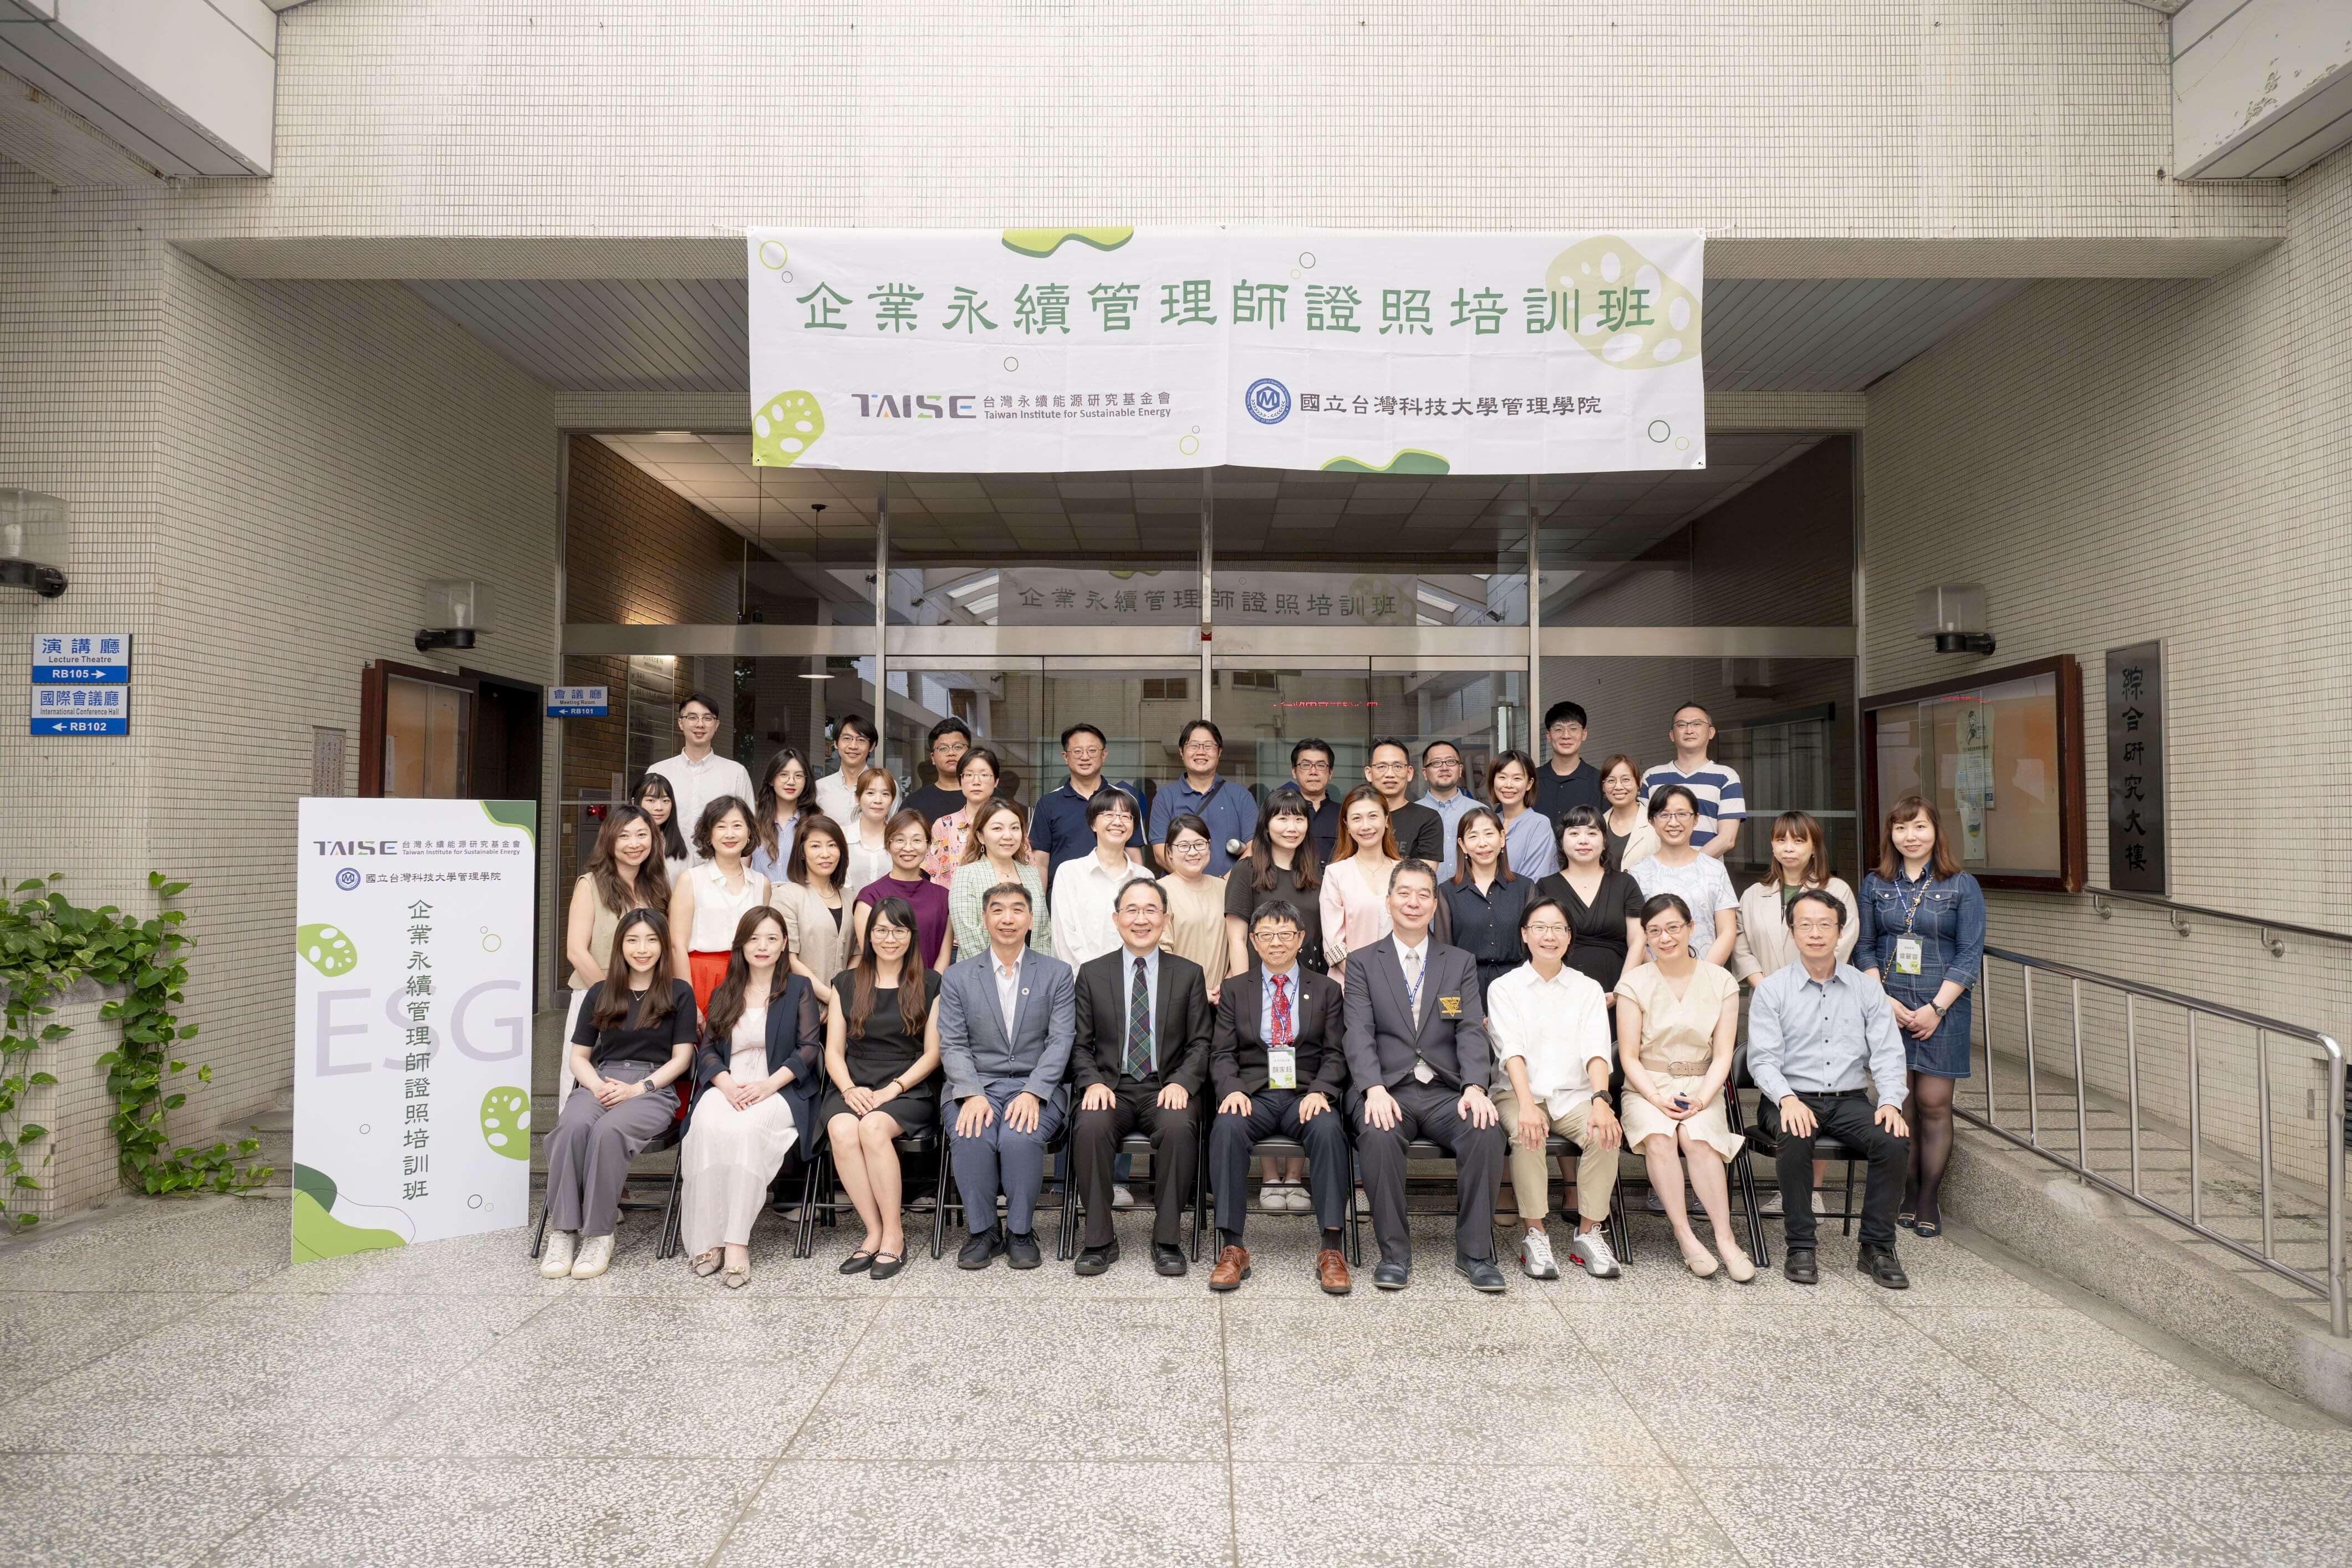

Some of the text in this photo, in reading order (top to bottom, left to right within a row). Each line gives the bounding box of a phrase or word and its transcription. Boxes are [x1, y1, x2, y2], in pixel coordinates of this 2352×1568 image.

[796, 279, 1655, 335] 企業永續管理師證照培訓班
[851, 394, 976, 419] TAISE
[983, 392, 1171, 409] 台灣永續能源研究基金會
[1300, 393, 1602, 417] 國立台灣科技大學管理學院
[984, 410, 1017, 419] Taiwan
[1020, 410, 1061, 418] Institute
[1080, 409, 1136, 418] Sustainable
[1138, 409, 1171, 418] Energy
[42, 638, 120, 654] 演講廳
[52, 669, 89, 678] RB105
[40, 690, 120, 707] 國際會議廳
[553, 689, 602, 699] 會議廳
[70, 722, 107, 731] RB102
[313, 841, 398, 856] TAISE
[403, 840, 520, 848] 台灣永續能源研究基金會
[366, 872, 502, 883] 國立台灣科技大學管理學院
[315, 979, 523, 1077] ESG
[403, 899, 434, 1201] 企業永續管理師證照培訓班
